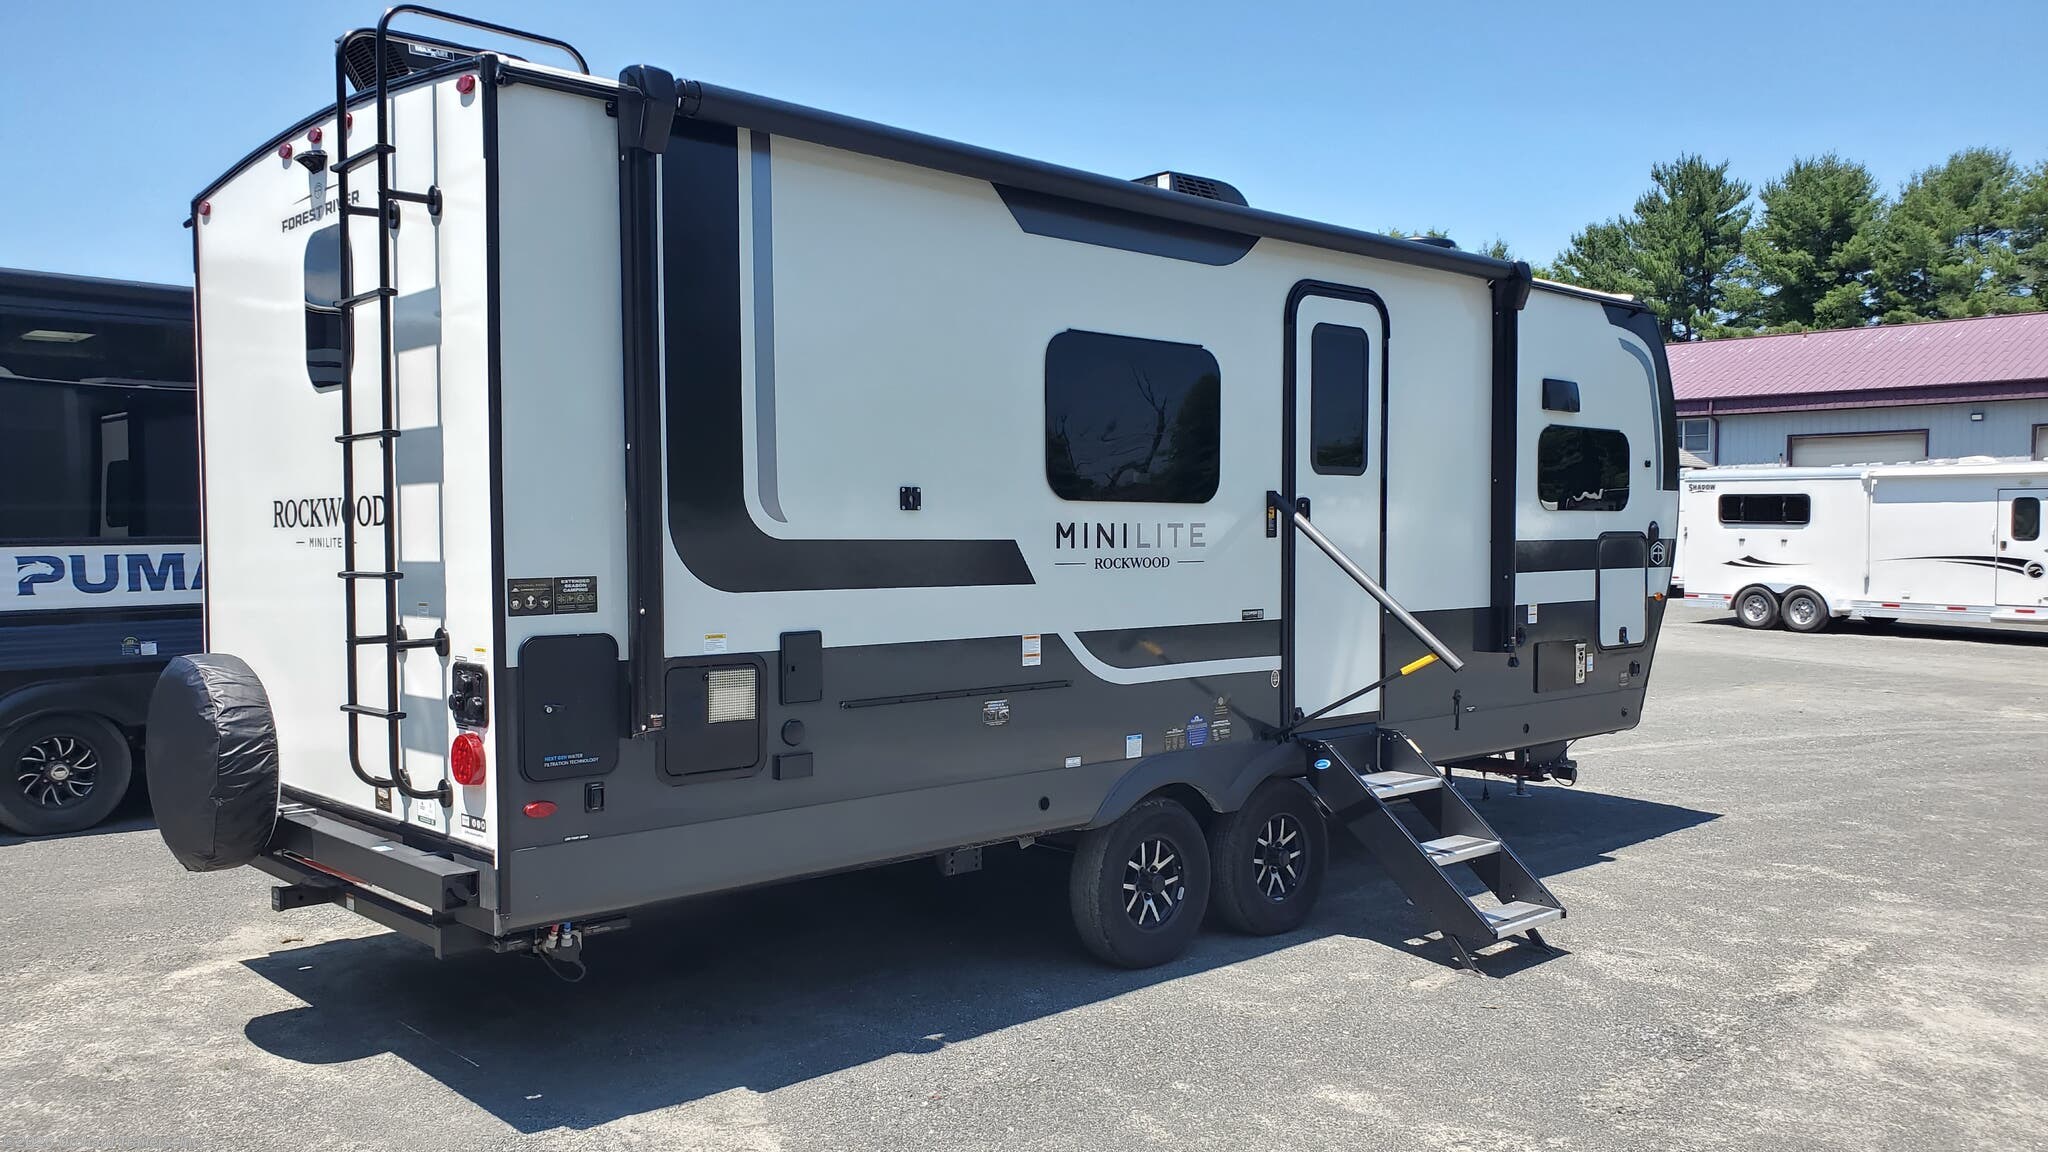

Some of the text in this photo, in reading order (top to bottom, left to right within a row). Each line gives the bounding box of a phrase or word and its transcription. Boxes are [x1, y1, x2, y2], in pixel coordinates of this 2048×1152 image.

[281, 205, 323, 232] FOREST
[273, 496, 385, 528] ROCKWOD
[309, 538, 343, 548] MINILITE
[14, 553, 203, 596] PUM
[1094, 557, 1171, 570] ROCKWOOD
